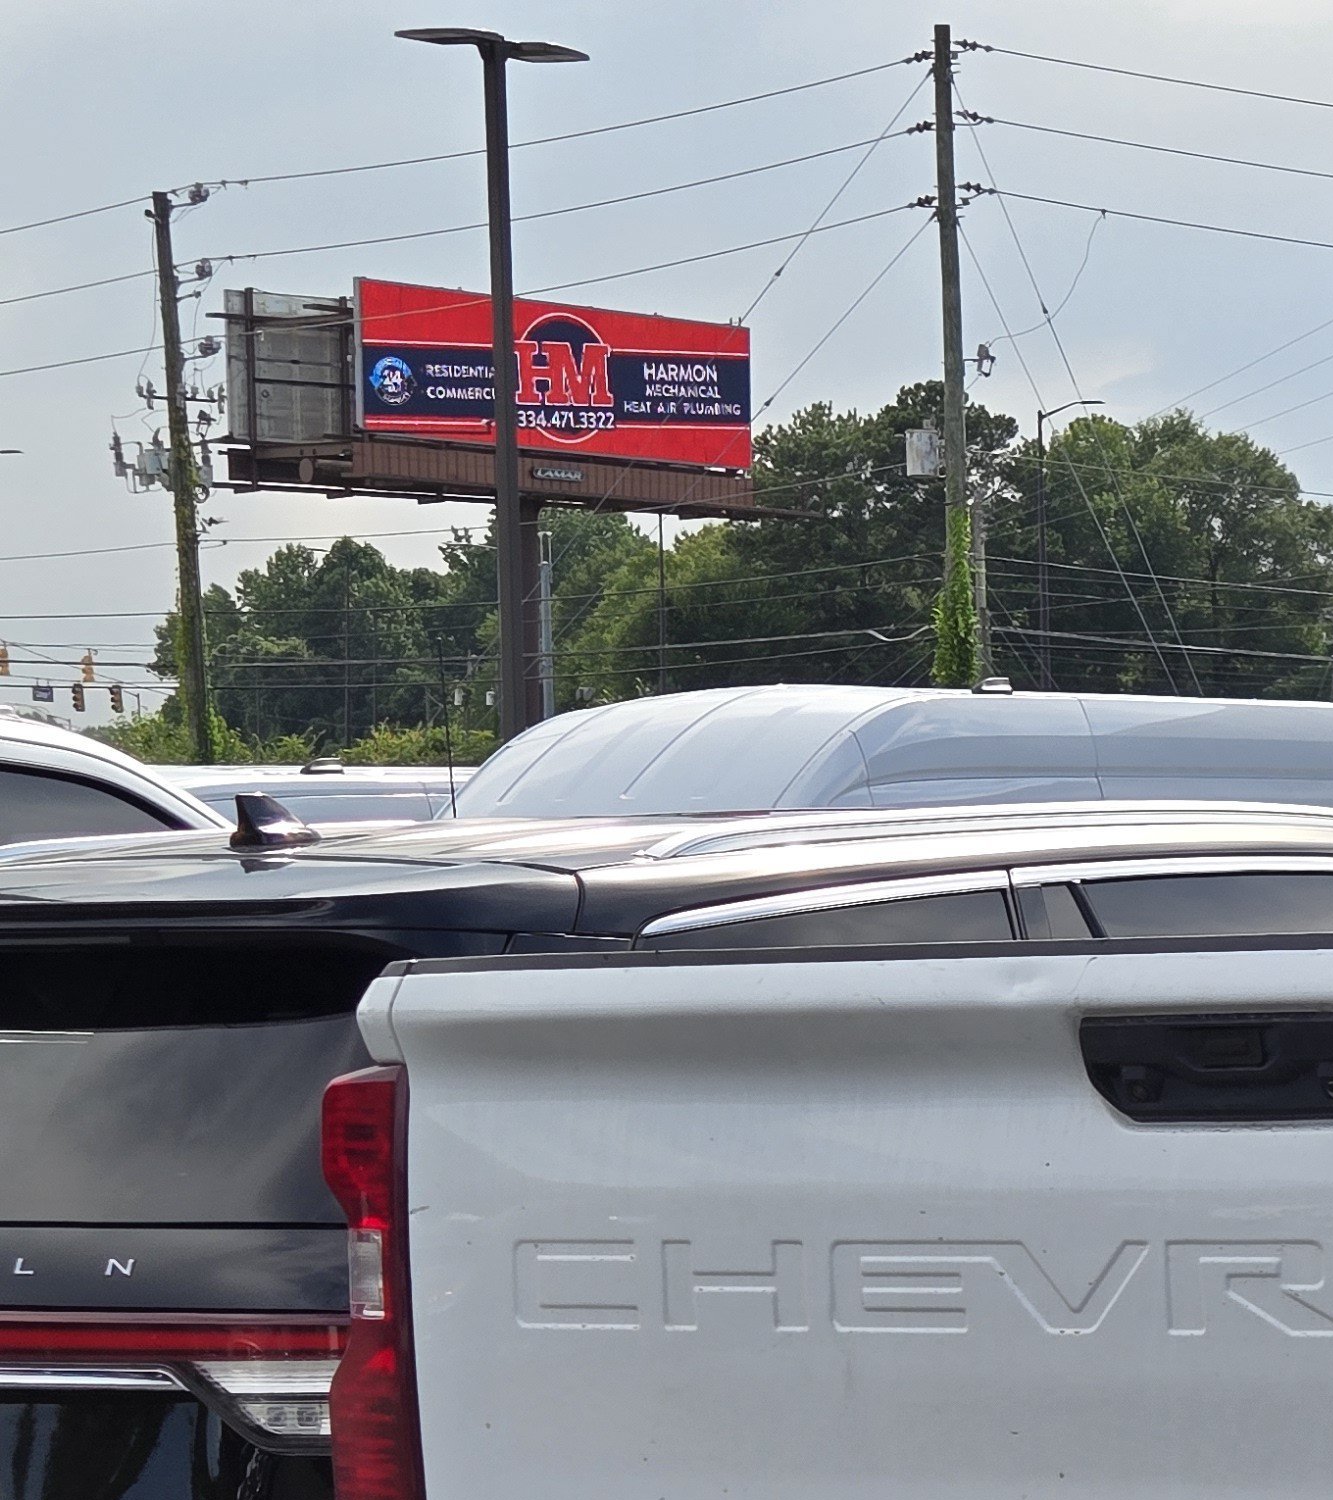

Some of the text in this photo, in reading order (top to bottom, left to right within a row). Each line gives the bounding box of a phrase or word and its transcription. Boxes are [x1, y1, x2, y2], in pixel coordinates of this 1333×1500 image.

[425, 364, 496, 379] RESIDENTIA
[513, 340, 614, 407] HM
[643, 362, 718, 383] HARMON
[426, 386, 496, 400] COMMERCI
[645, 384, 722, 399] MECHANICAL
[623, 401, 742, 416] HEAT AIR PLUMBING
[517, 410, 616, 429] 334.471.3322
[537, 468, 583, 481] LAMAR
